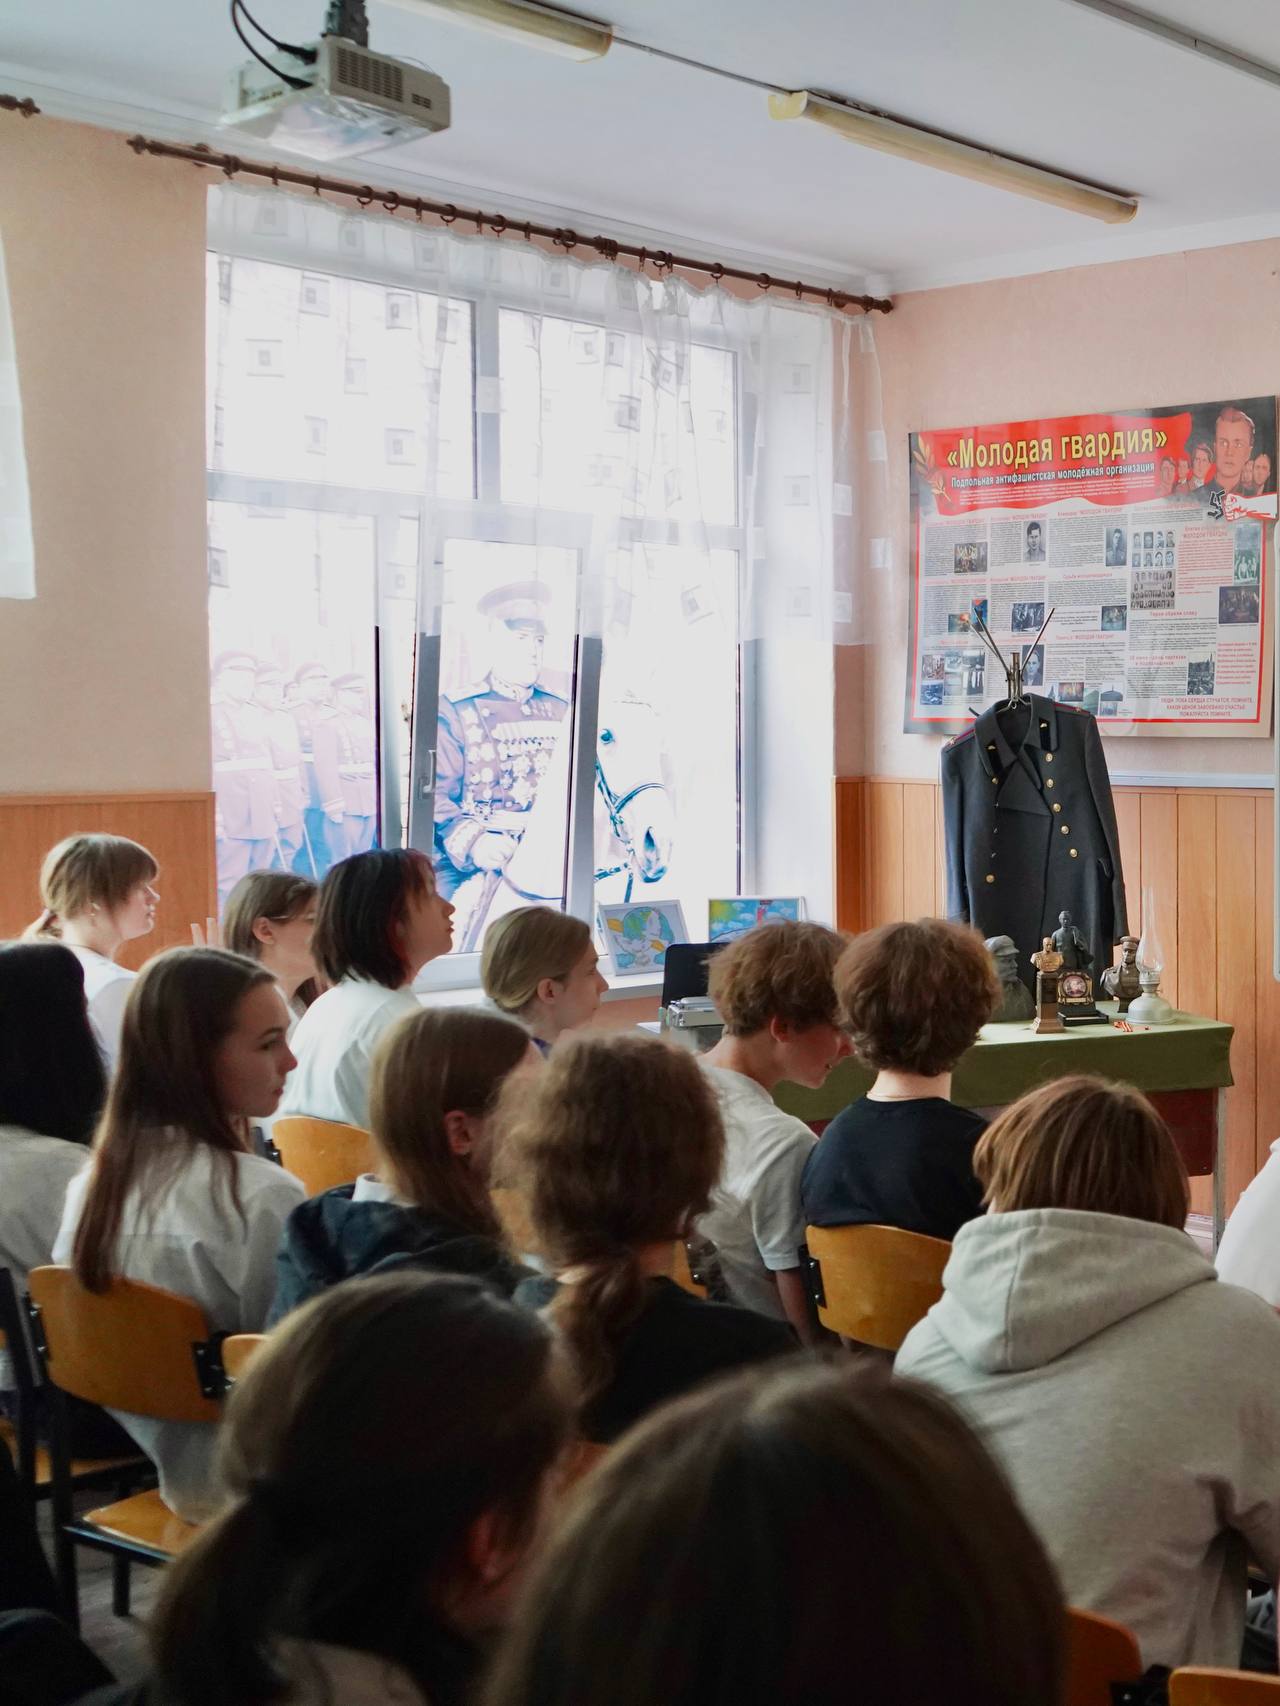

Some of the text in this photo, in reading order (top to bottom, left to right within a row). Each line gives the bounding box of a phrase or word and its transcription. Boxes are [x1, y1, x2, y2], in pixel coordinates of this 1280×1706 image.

[947, 428, 1168, 470] «Молодая гвардия»
[951, 475, 995, 489] Подпольная
[995, 470, 1056, 487] антифашистская
[1106, 462, 1155, 477] организация
